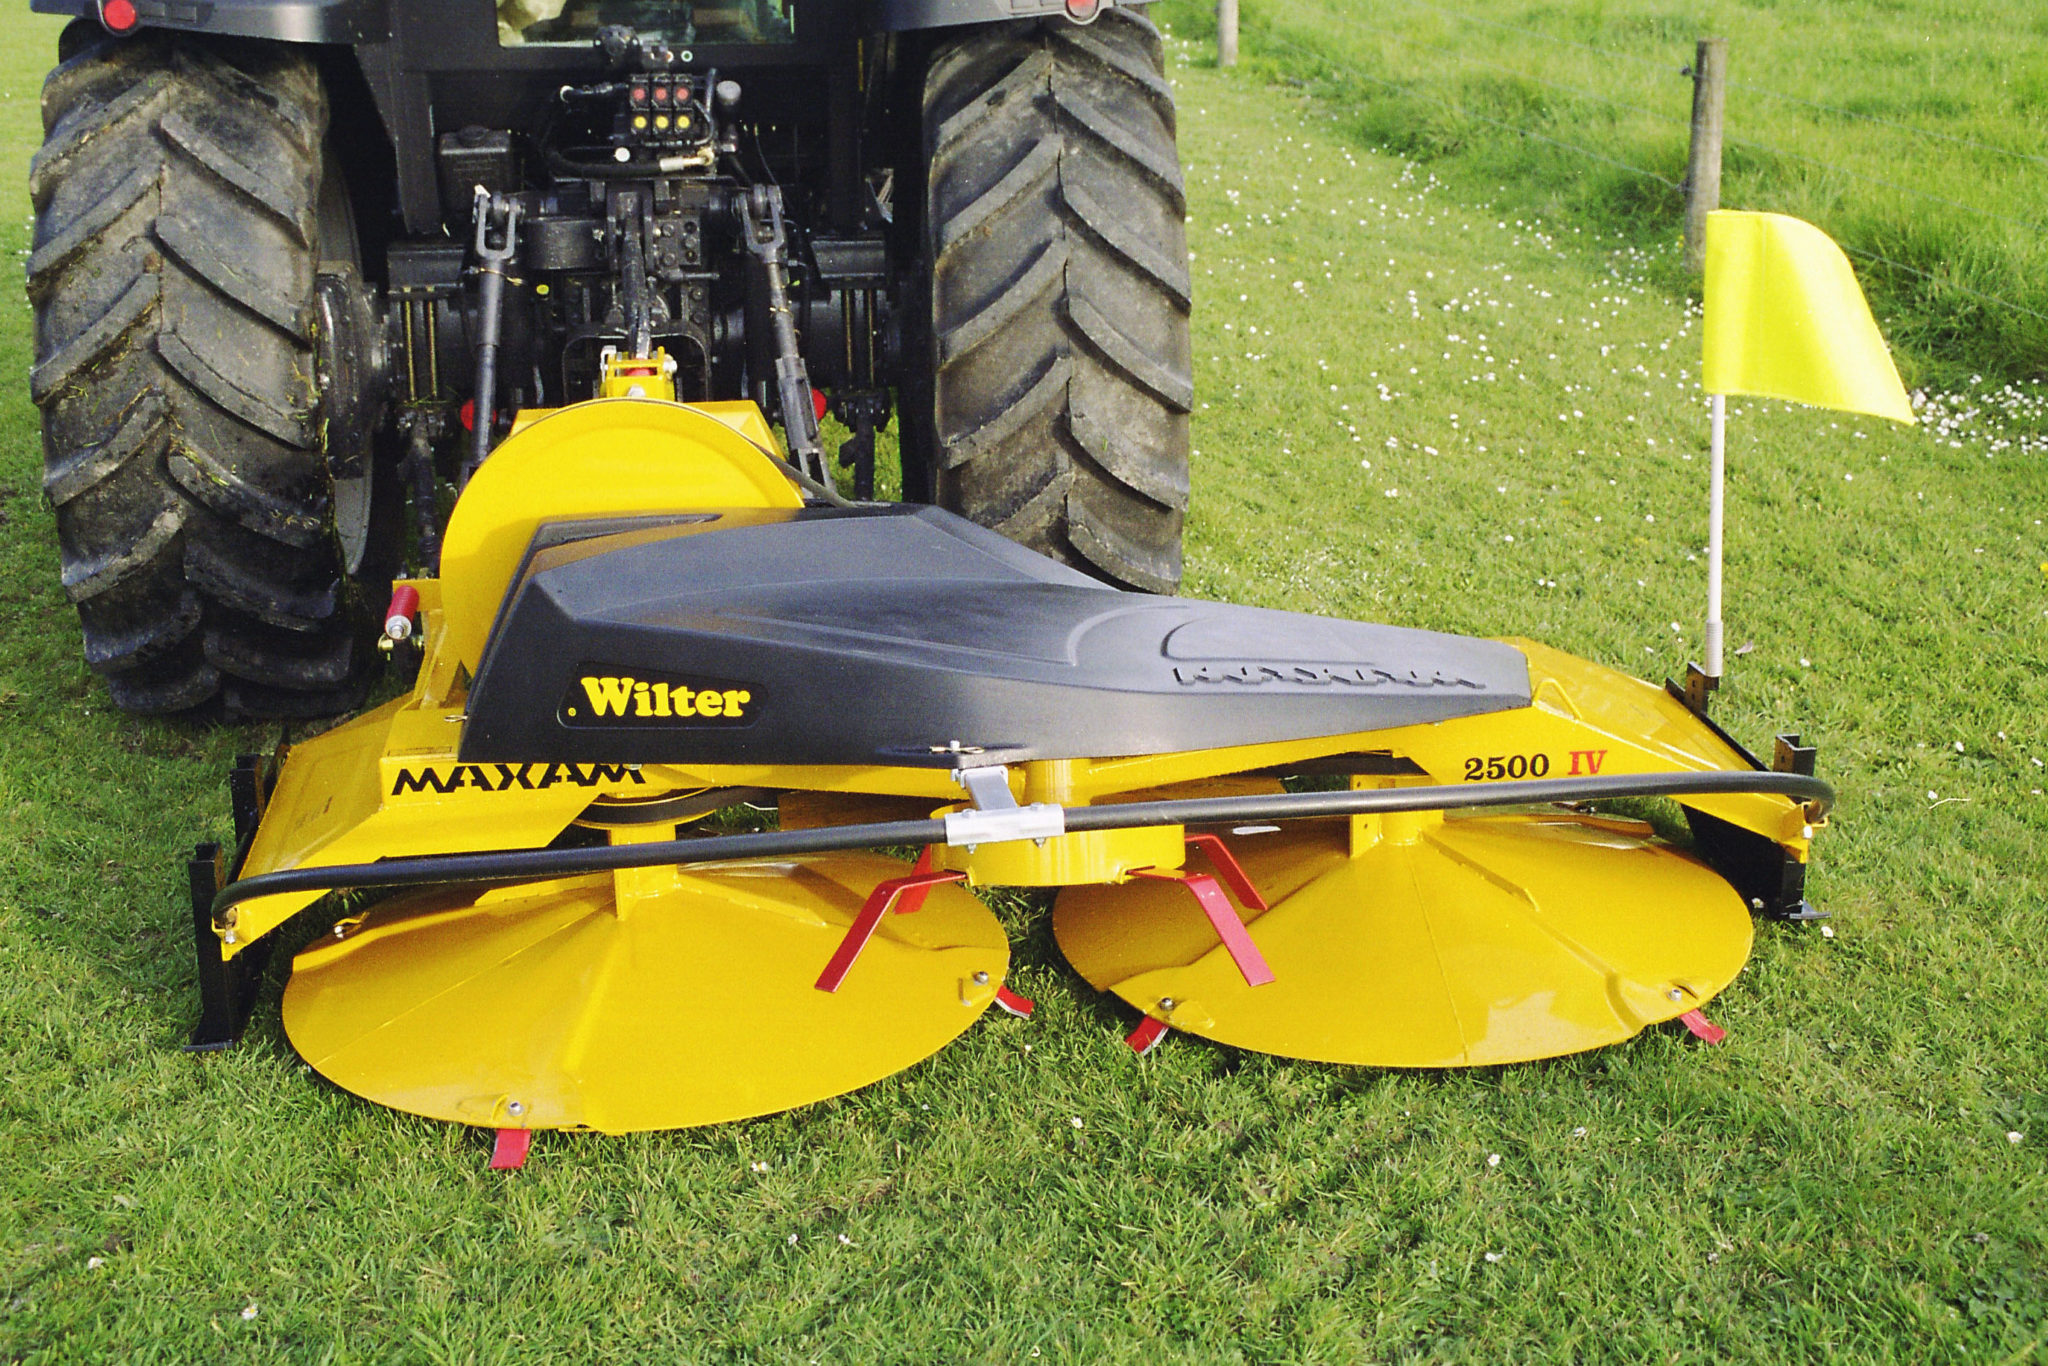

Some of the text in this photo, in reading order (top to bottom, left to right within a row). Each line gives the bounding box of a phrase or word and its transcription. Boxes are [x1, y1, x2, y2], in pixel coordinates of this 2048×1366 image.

[580, 676, 751, 717] Wilter
[390, 763, 647, 796] MAXAM
[1464, 749, 1608, 781] 2500 IV
